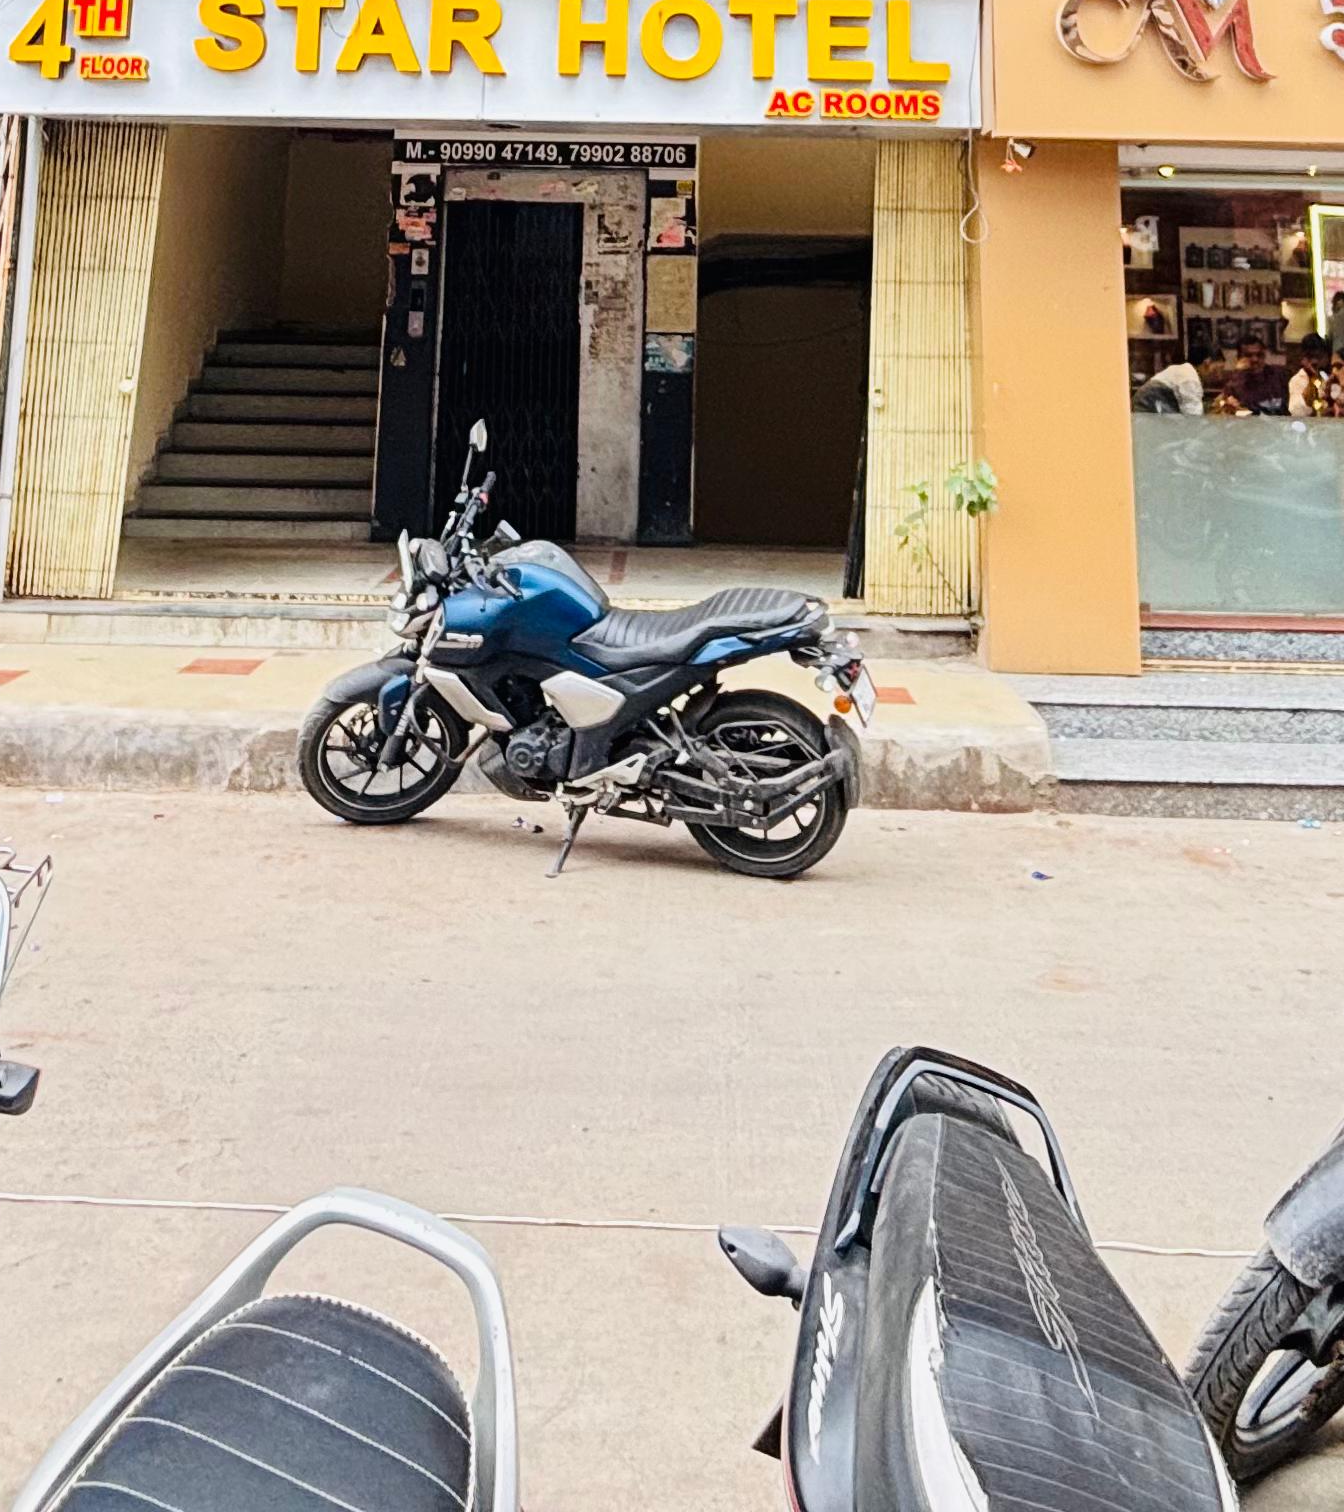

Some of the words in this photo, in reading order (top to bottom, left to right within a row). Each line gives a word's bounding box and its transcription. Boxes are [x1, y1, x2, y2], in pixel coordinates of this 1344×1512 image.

[78, 55, 147, 80] FLOOR
[767, 88, 814, 118] AC
[821, 89, 944, 120] ROOMS
[440, 142, 496, 161] 90990
[501, 143, 563, 164] 47149,
[569, 144, 625, 163] 79902
[630, 145, 687, 164] 88706
